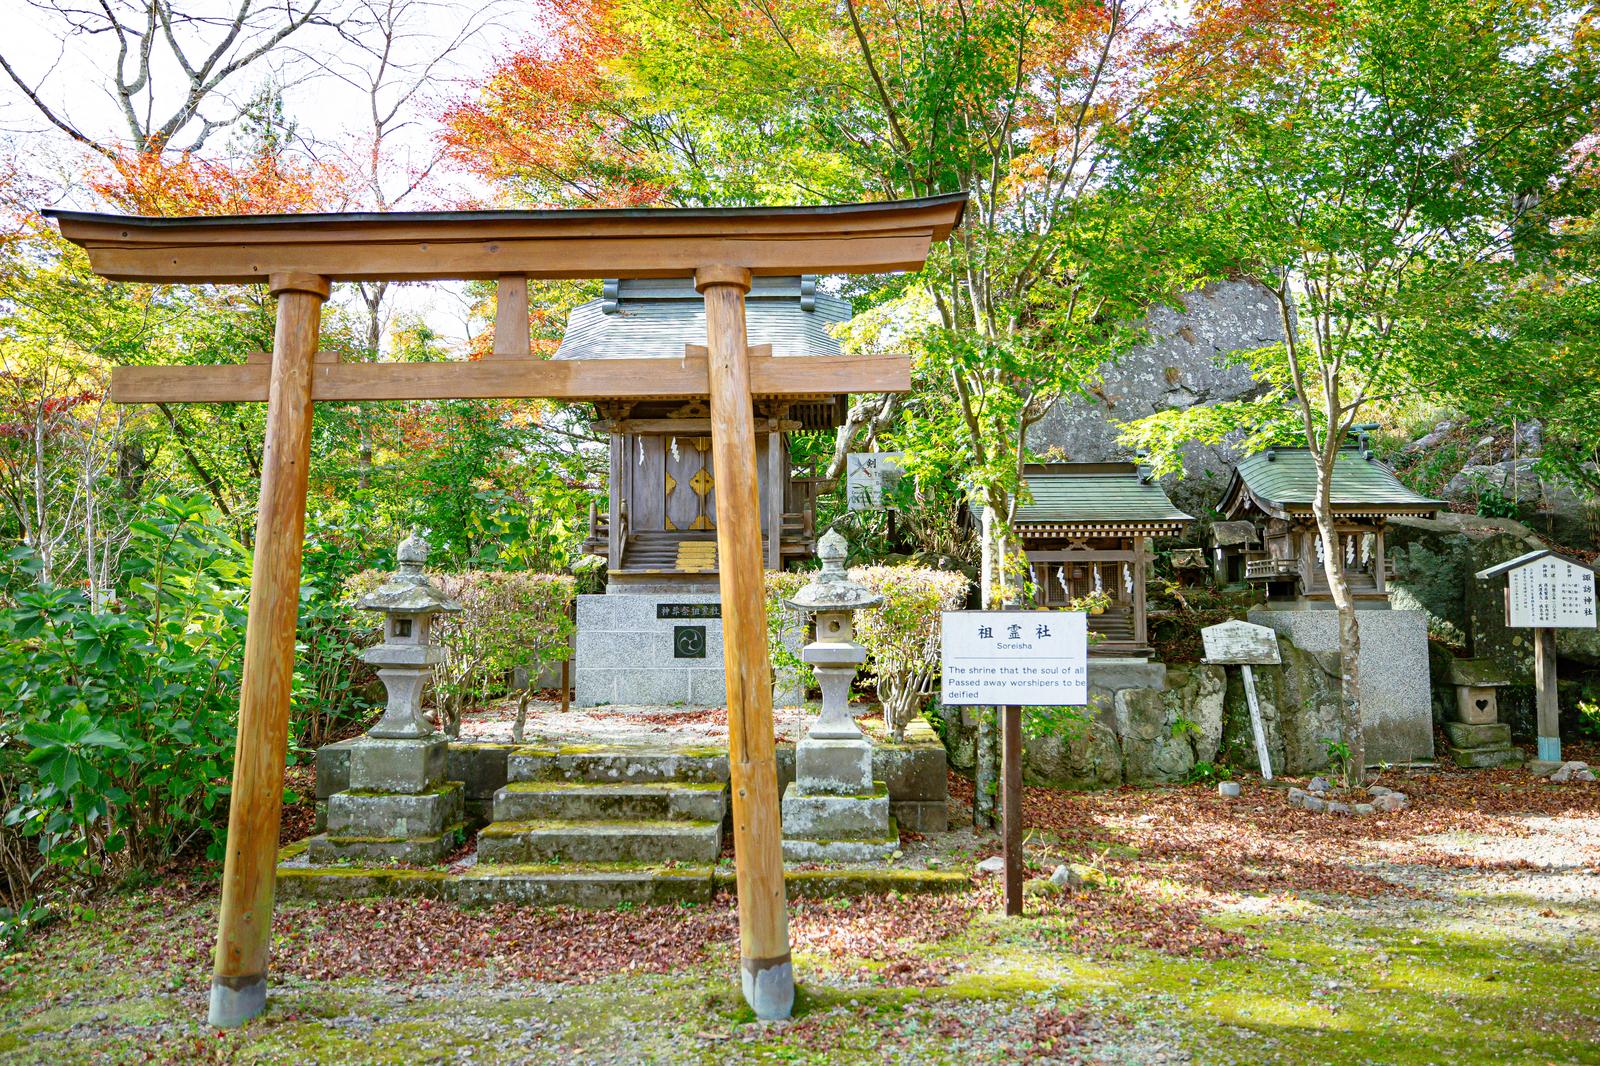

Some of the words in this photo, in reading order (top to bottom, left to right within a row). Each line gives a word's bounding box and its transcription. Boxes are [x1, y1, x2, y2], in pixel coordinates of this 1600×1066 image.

[1582, 573, 1593, 617] 諏訪神社
[977, 623, 1052, 640] 祖霊社
[996, 642, 1033, 650] Soreisha
[948, 666, 966, 675] The
[968, 666, 997, 675] shrine
[1000, 666, 1019, 675] that
[1023, 666, 1038, 675] the
[1040, 666, 1059, 675] soul
[1061, 666, 1072, 675] of
[1074, 666, 1085, 675] all
[948, 678, 981, 687] Passed
[983, 680, 1007, 688] away
[1010, 678, 1060, 688] worshipers
[1062, 678, 1073, 687] to
[1075, 678, 1086, 687] be
[948, 690, 979, 699] deified
